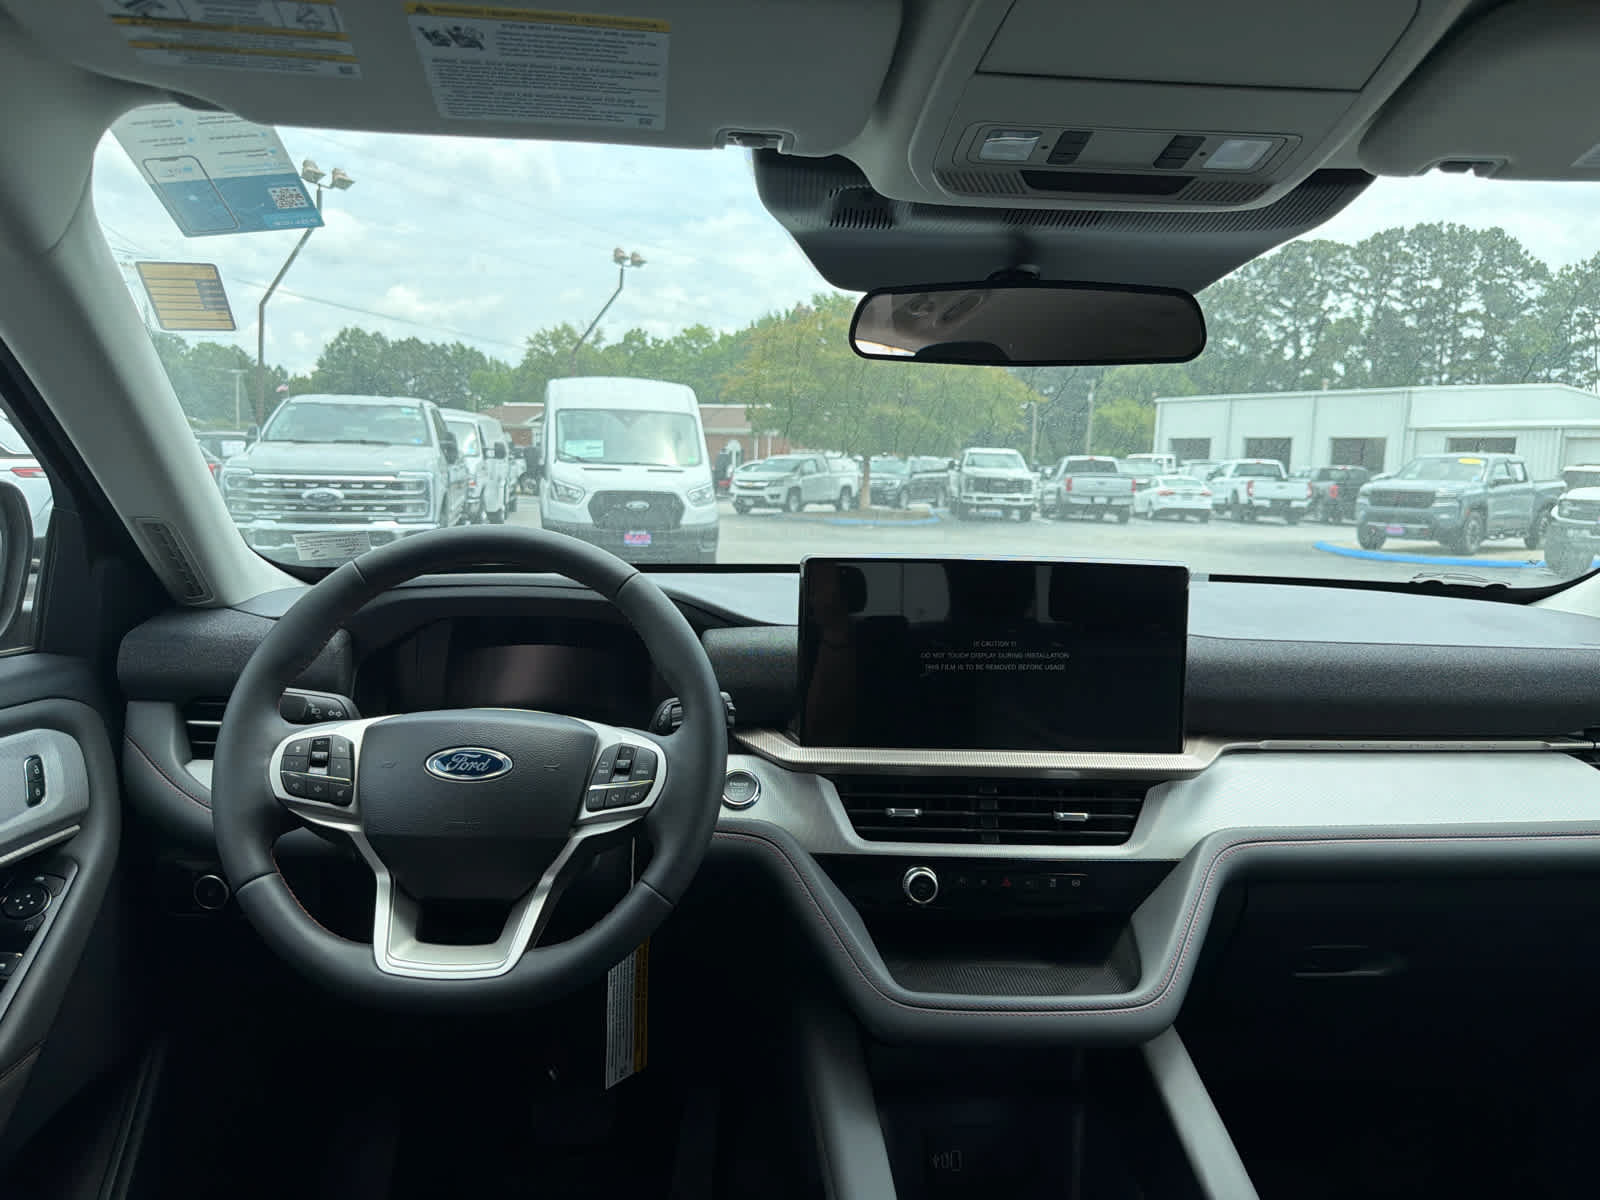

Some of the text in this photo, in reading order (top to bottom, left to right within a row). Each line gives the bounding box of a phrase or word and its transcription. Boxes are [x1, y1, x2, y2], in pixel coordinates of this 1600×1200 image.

[980, 640, 1009, 648] CAUTION
[925, 663, 1065, 671] THIS FILM IS TO BE REMOVED BEFORE USAGE
[446, 753, 491, 772] Ford
